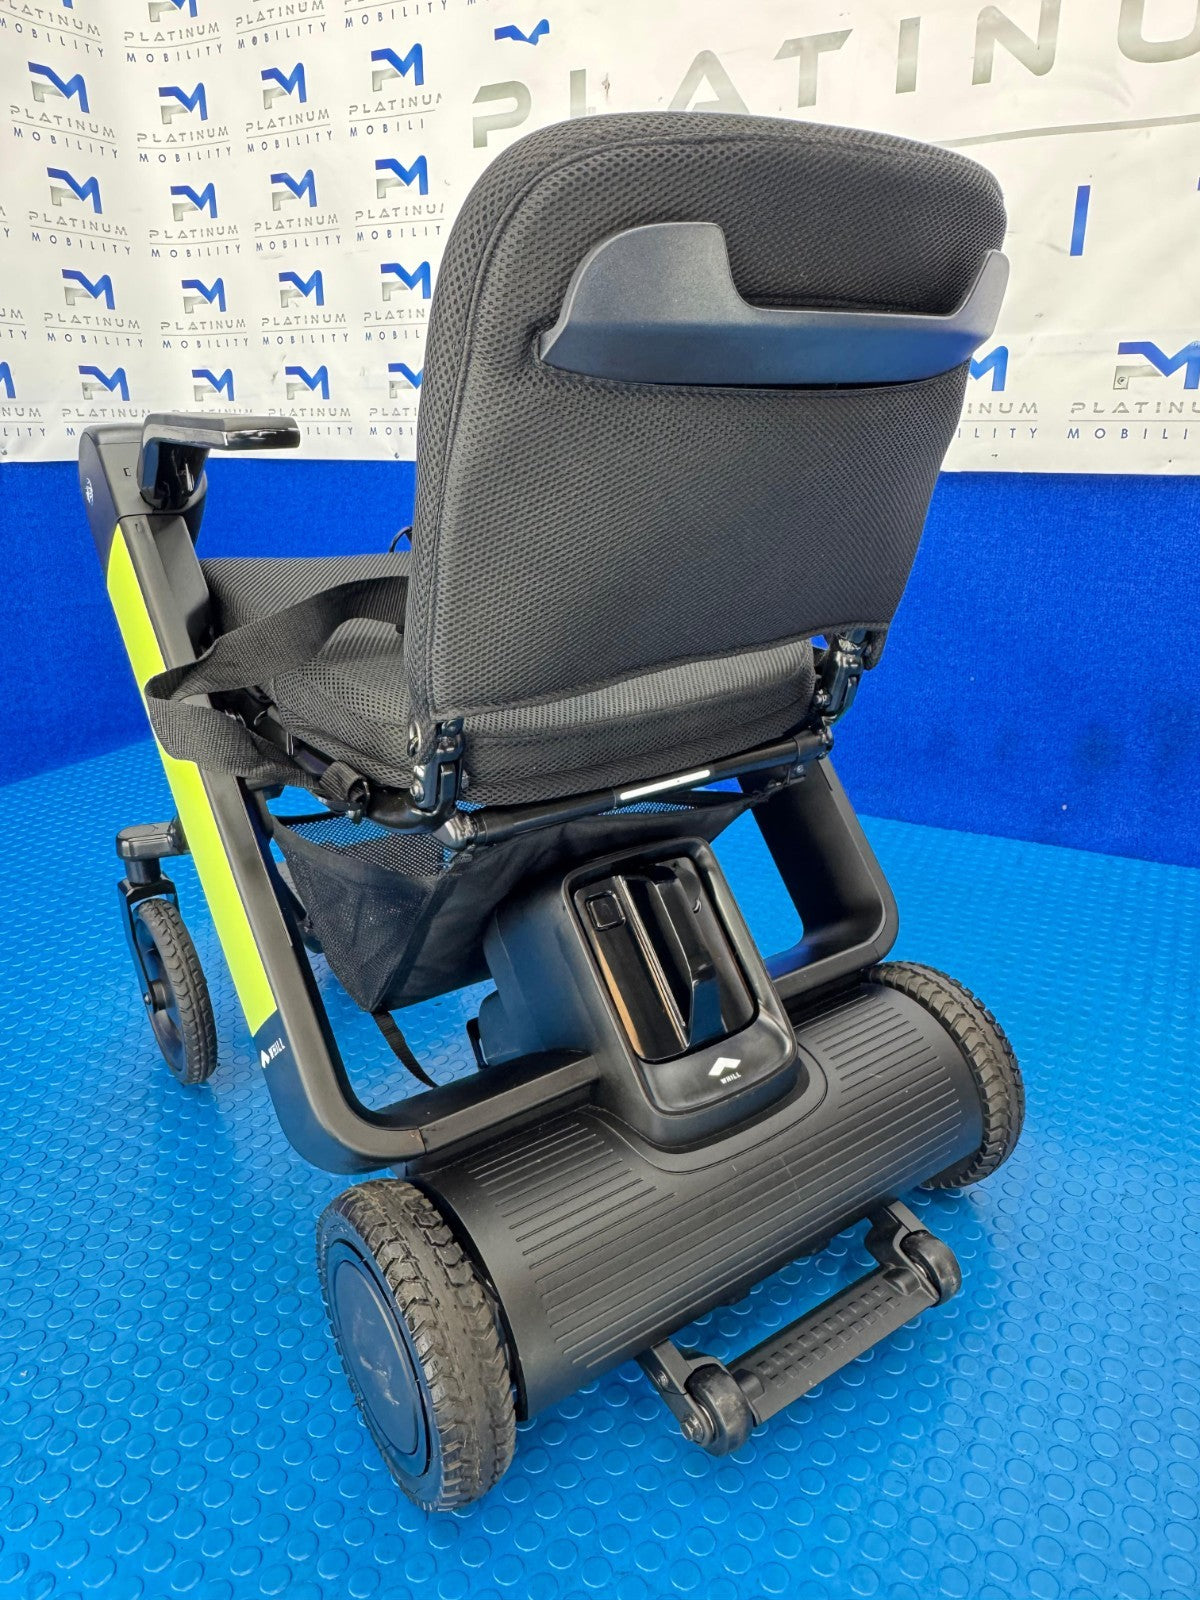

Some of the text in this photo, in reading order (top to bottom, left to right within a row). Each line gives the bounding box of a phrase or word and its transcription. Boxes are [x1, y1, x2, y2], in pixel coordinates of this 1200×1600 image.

[2, 0, 100, 36] LATINUM
[235, 0, 324, 27] PLATINUM
[344, 0, 447, 28] MOBILITY
[124, 22, 220, 42] PLATINUM
[237, 21, 327, 49] MOBILITY
[126, 44, 222, 62] MOBILITY
[10, 105, 115, 138] PLATINUM
[245, 108, 330, 132] PLATINUM
[137, 126, 229, 143] PLATINUM
[247, 130, 333, 153] MOBILITY
[14, 127, 118, 159] MOBILITY
[139, 146, 231, 163] MOBILITY
[29, 211, 128, 236] PLATINUM
[254, 213, 339, 232] PLATINUM
[149, 224, 239, 239] PLATINUM
[31, 232, 131, 255] MOBILITY
[151, 244, 241, 258] MOBILITY
[256, 235, 342, 252] MOBILITY
[44, 312, 141, 329] PLATINUM
[261, 313, 347, 327] PLATINUM
[363, 308, 425, 322] PLATIN
[160, 318, 246, 331] PLATINUM
[47, 333, 143, 348] MOBILITY
[262, 333, 349, 345] MOBILITY
[365, 329, 420, 341] MOBIL
[162, 337, 249, 349] MOBILITY
[268, 407, 351, 417] PLATINUM
[369, 407, 417, 417] PLATI
[967, 402, 1038, 414] INUM
[1070, 402, 1200, 414] PLATINU
[3, 428, 46, 437] LITY
[306, 427, 353, 436] ILITY
[369, 427, 413, 436] MOBI
[958, 428, 1037, 439] ILITY
[1067, 428, 1188, 440] MOBILI
